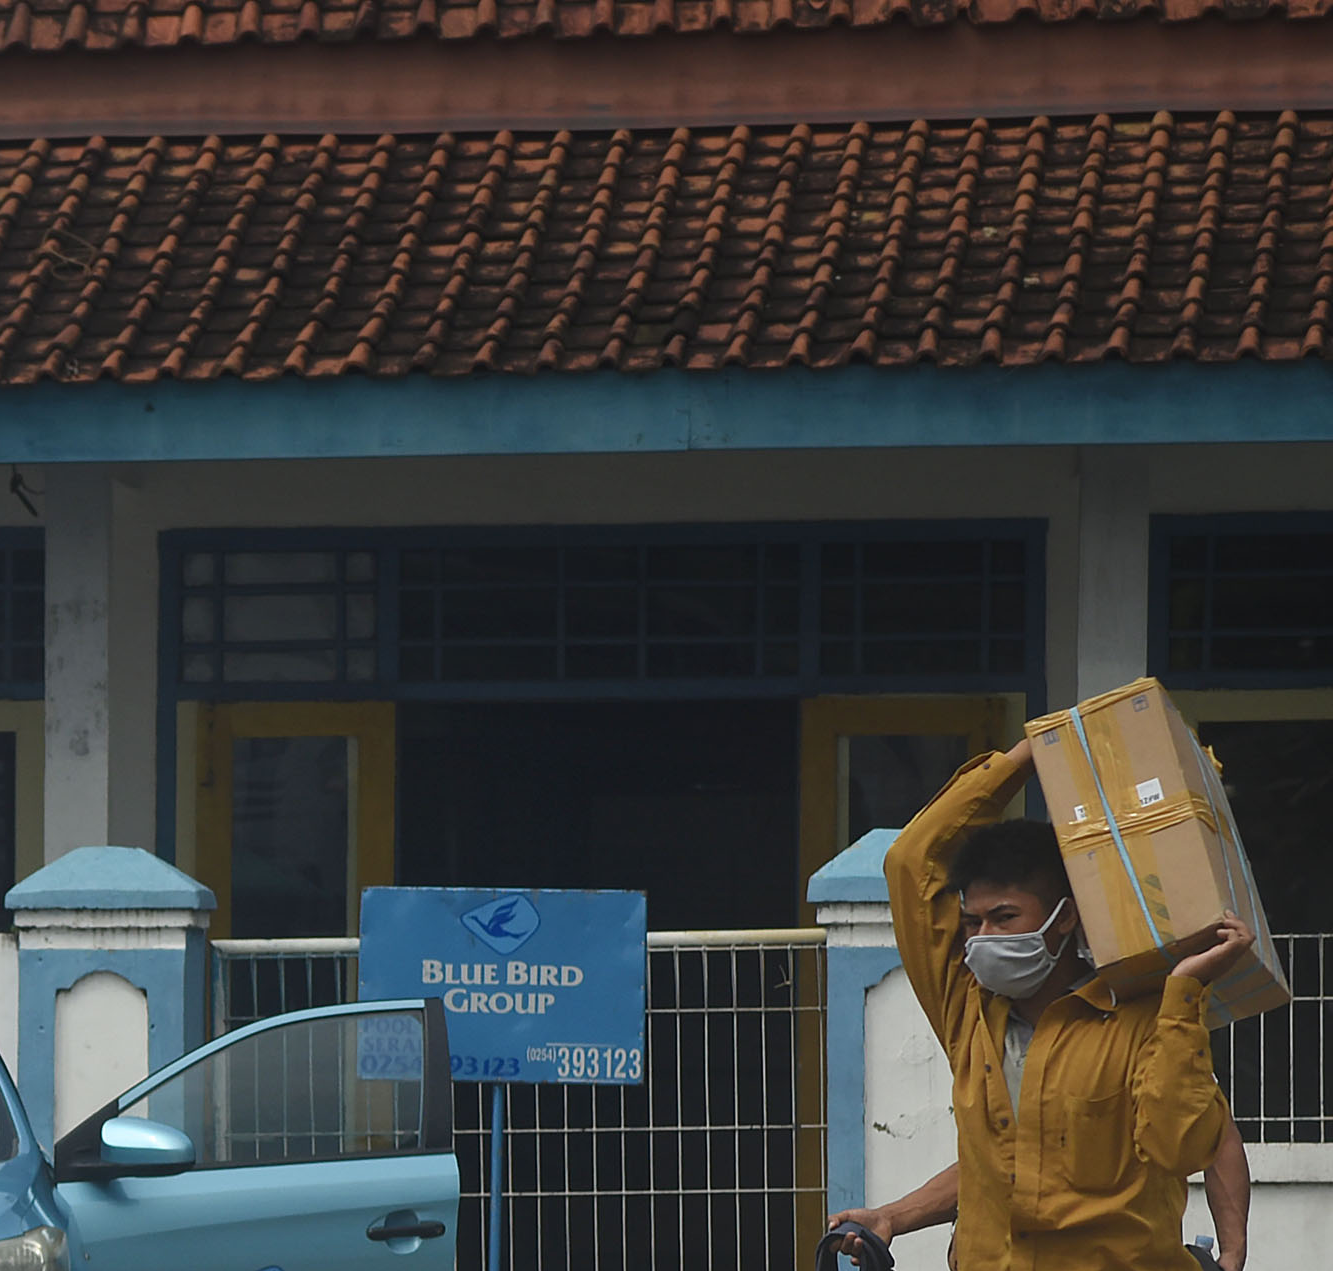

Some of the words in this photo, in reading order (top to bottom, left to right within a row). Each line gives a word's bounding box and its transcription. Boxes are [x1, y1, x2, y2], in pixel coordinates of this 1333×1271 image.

[422, 959, 499, 985] BLUE
[506, 960, 584, 987] BIRD
[443, 988, 555, 1015] GROUP
[364, 1036, 421, 1053] SERA
[557, 1047, 642, 1080] 393123
